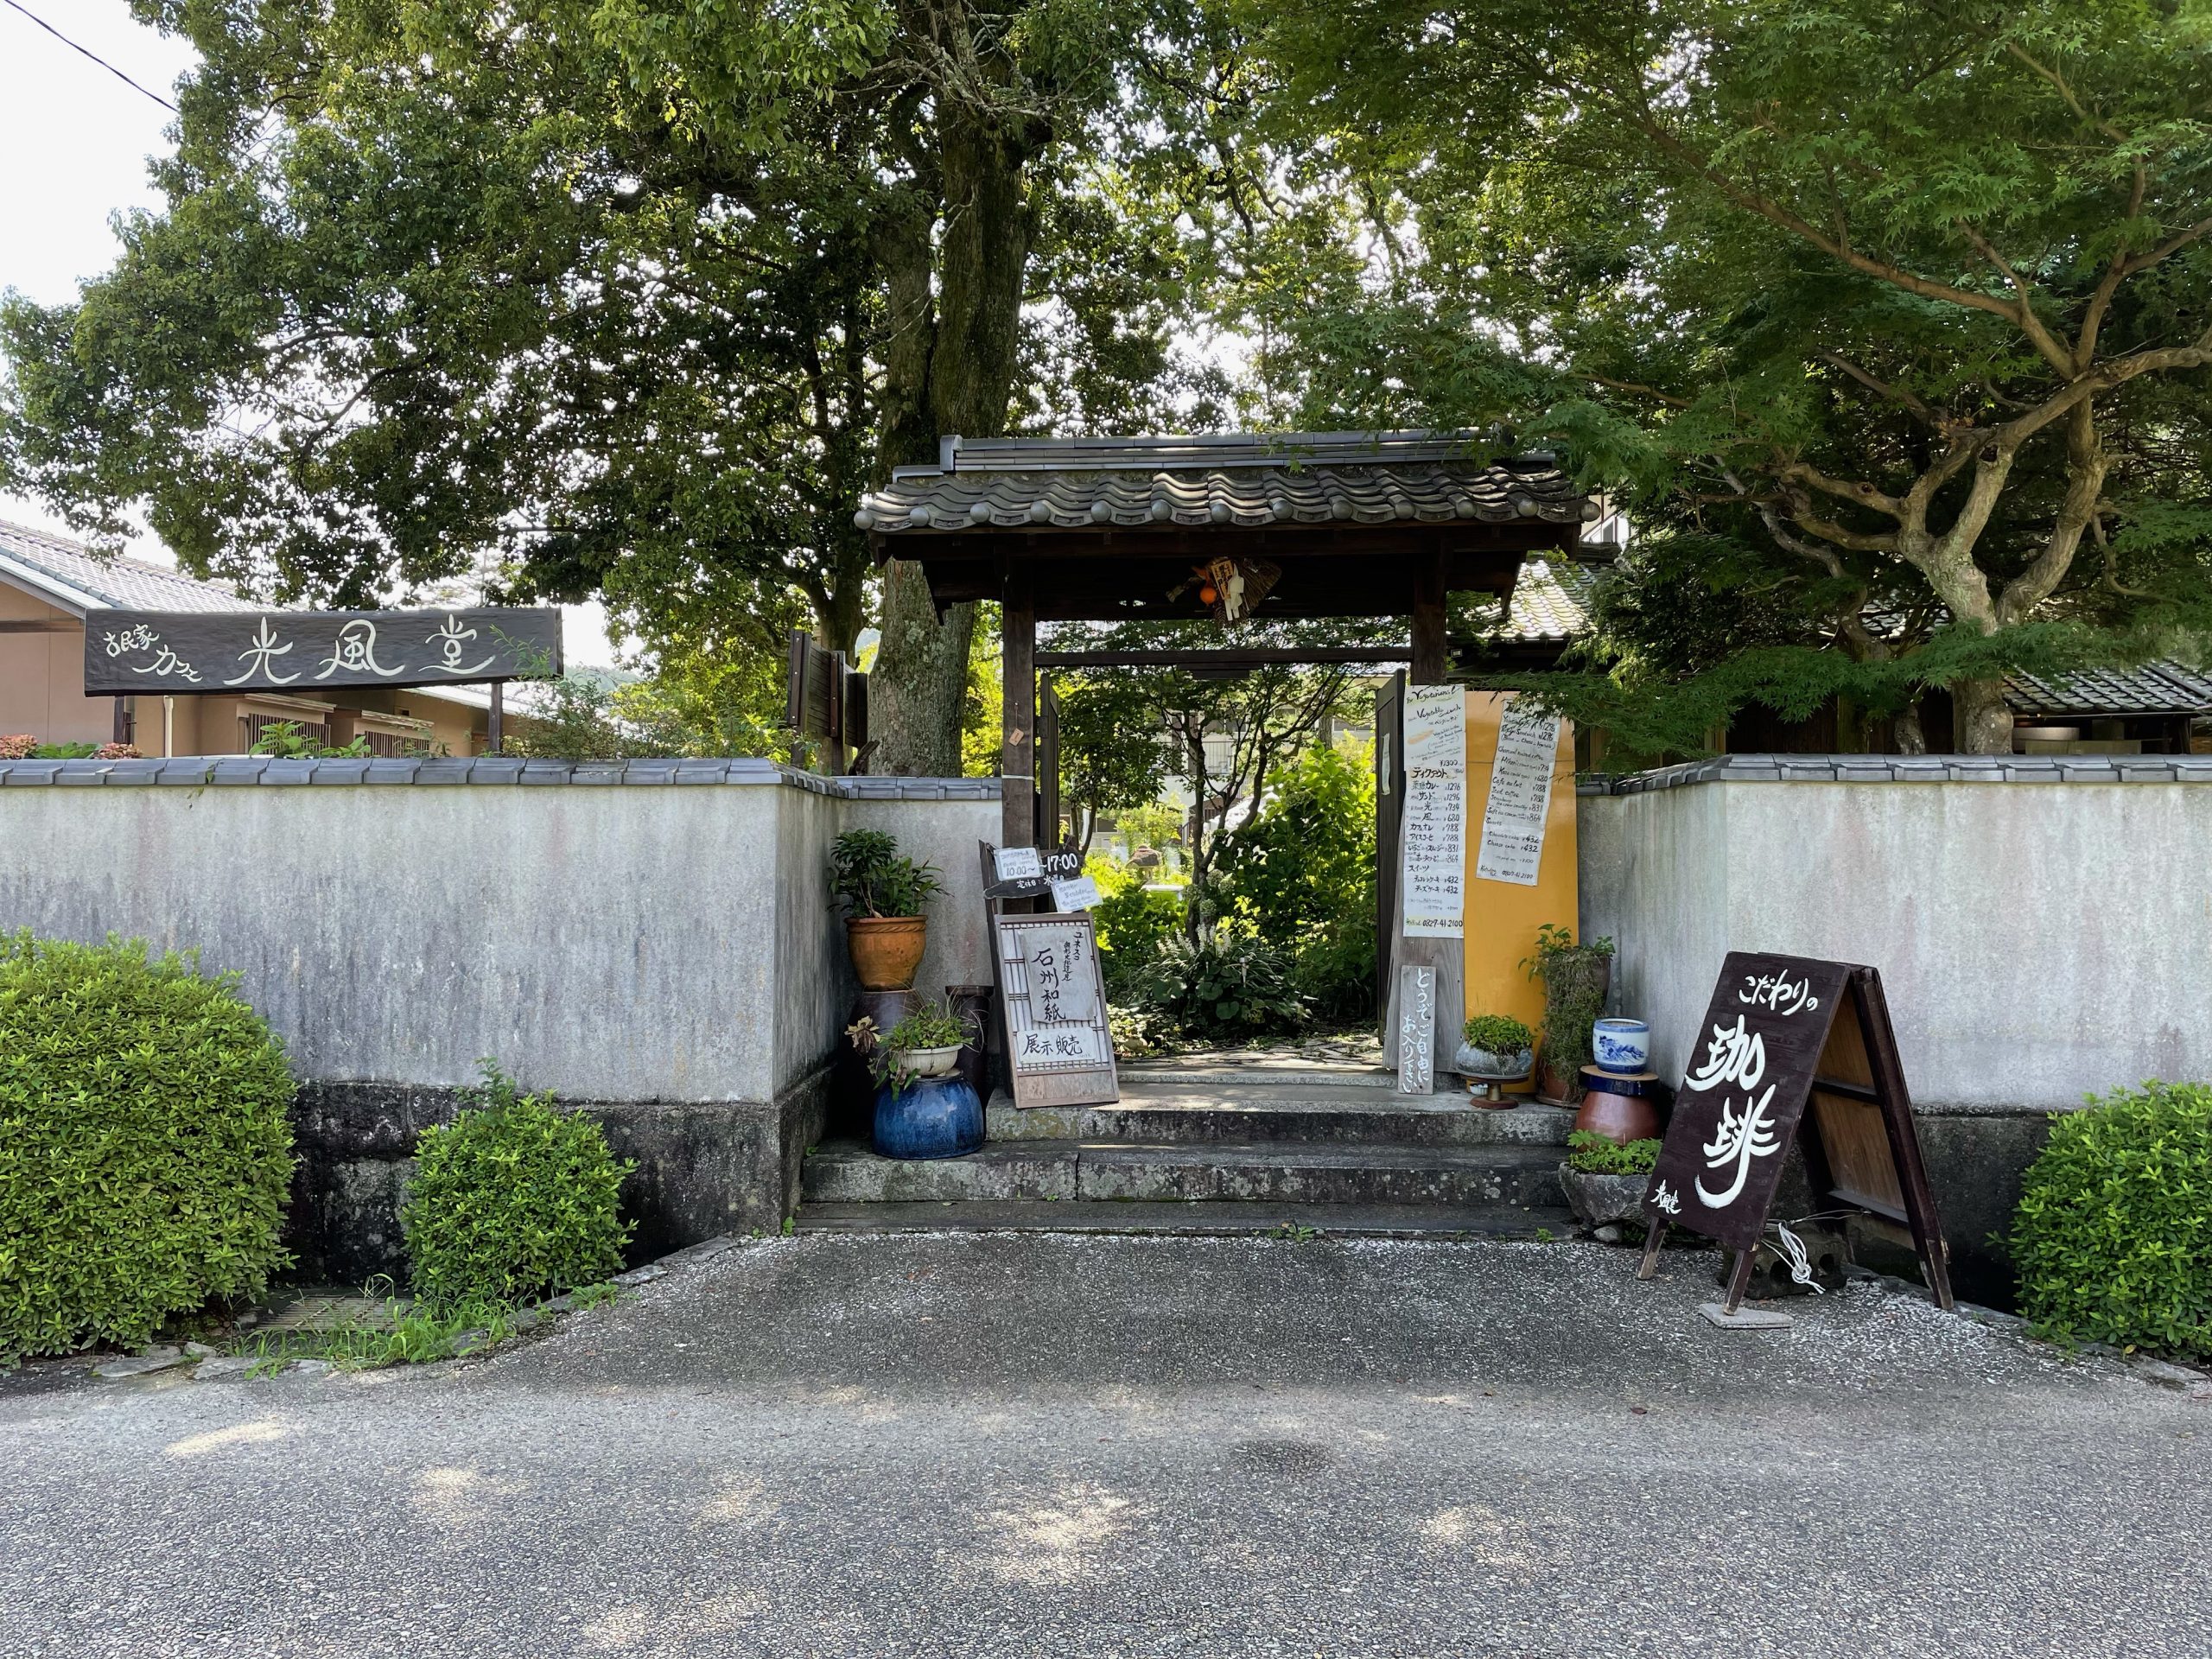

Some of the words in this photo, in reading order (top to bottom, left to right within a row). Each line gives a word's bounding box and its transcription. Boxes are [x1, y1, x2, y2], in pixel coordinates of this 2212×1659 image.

[103, 624, 159, 658] 古民家
[131, 644, 203, 683] カフェ
[222, 613, 497, 686] 光風堂
[1073, 931, 1084, 960] ユネスコ
[1031, 947, 1066, 1021] 石州和紙
[1738, 969, 1818, 1016] こだわりの
[1022, 1033, 1084, 1056] 展示販売
[1402, 1014, 1418, 1093] お入り下さい
[1416, 967, 1433, 1083] どうぞご自由に
[1685, 1014, 1781, 1210] 珈琲
